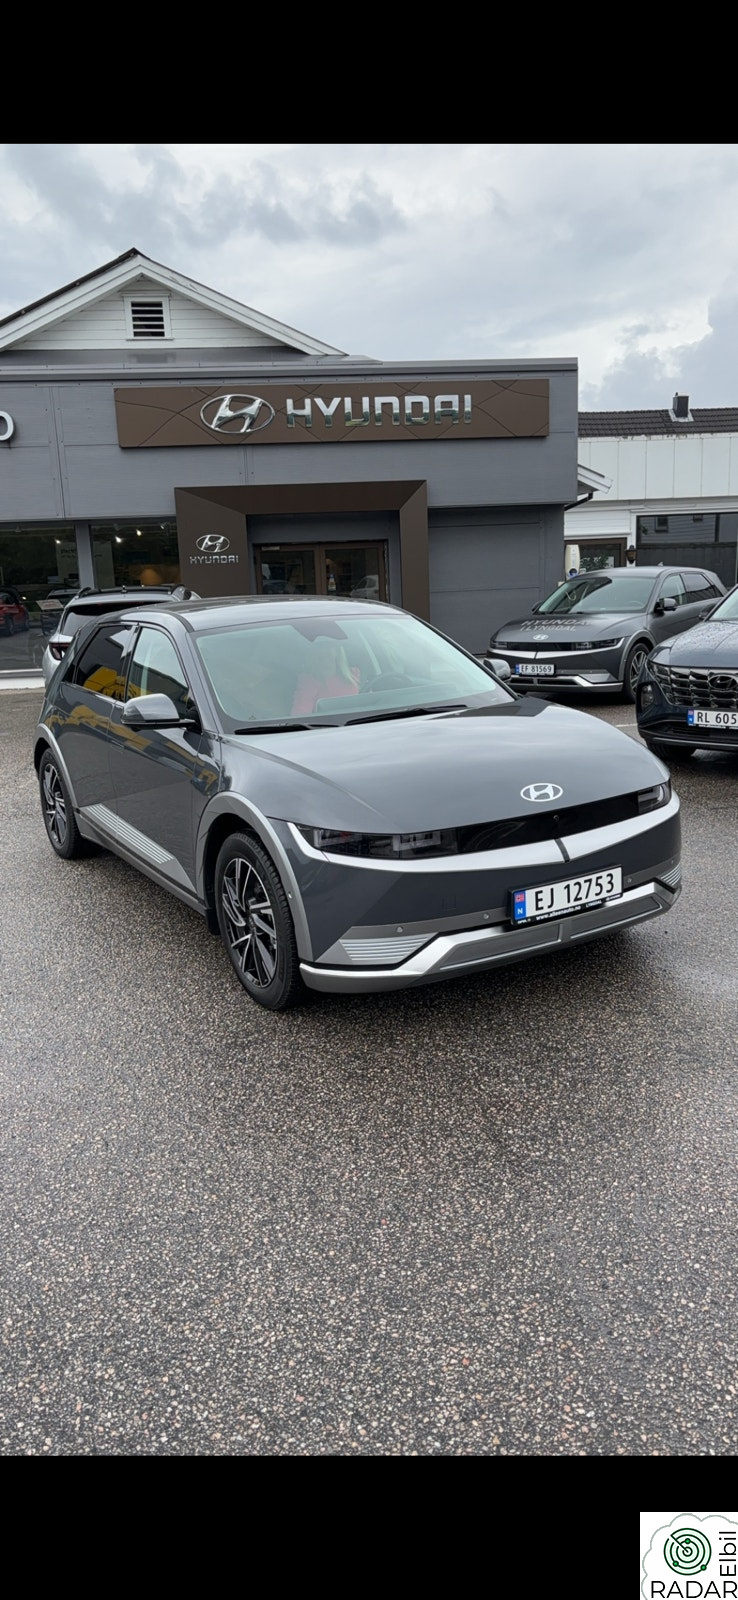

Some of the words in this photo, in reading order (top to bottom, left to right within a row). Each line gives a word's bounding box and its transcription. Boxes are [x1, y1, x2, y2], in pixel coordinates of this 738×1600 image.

[286, 394, 472, 428] HYUNDAI
[189, 555, 239, 564] HYUNDAI
[521, 665, 529, 673] EF
[531, 665, 552, 673] 81569
[697, 711, 710, 723] RL
[534, 887, 555, 912] EJ
[563, 872, 615, 904] 12753
